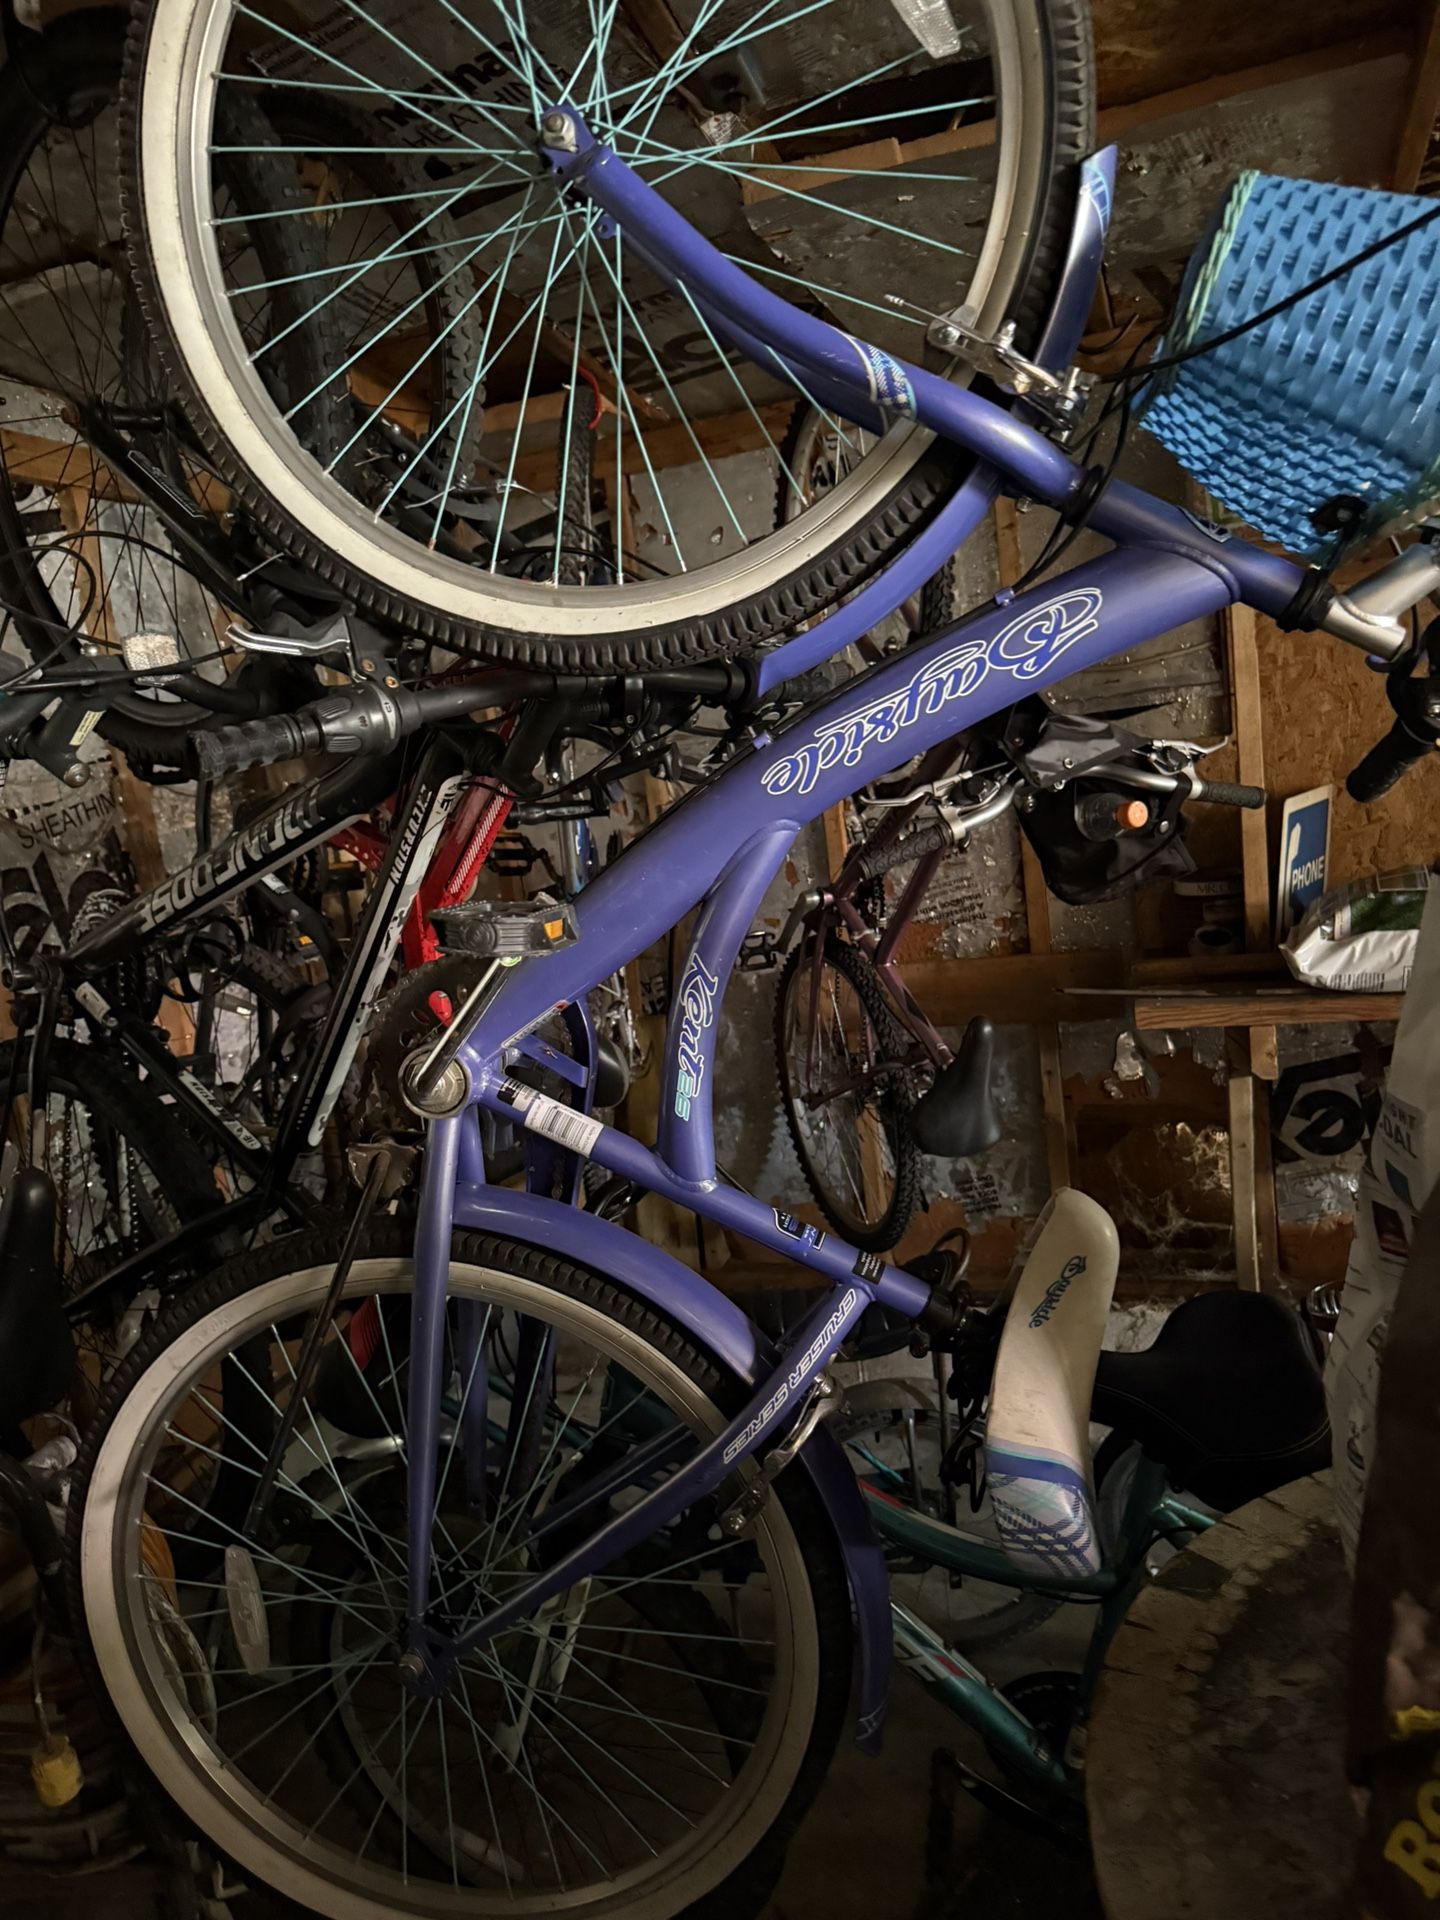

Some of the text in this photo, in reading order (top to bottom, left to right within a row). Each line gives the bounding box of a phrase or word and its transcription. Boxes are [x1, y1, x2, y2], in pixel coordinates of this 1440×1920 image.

[401, 62, 573, 149] HEATHING
[761, 587, 1103, 795] Bayside
[16, 791, 116, 850] SHEATHIN
[135, 783, 327, 936] MONGOOSE
[1290, 854, 1325, 893] PHONE
[674, 951, 719, 1122] Kent 26
[1028, 1255, 1088, 1329] Bayside
[722, 1287, 856, 1465] CRUISER SERIES
